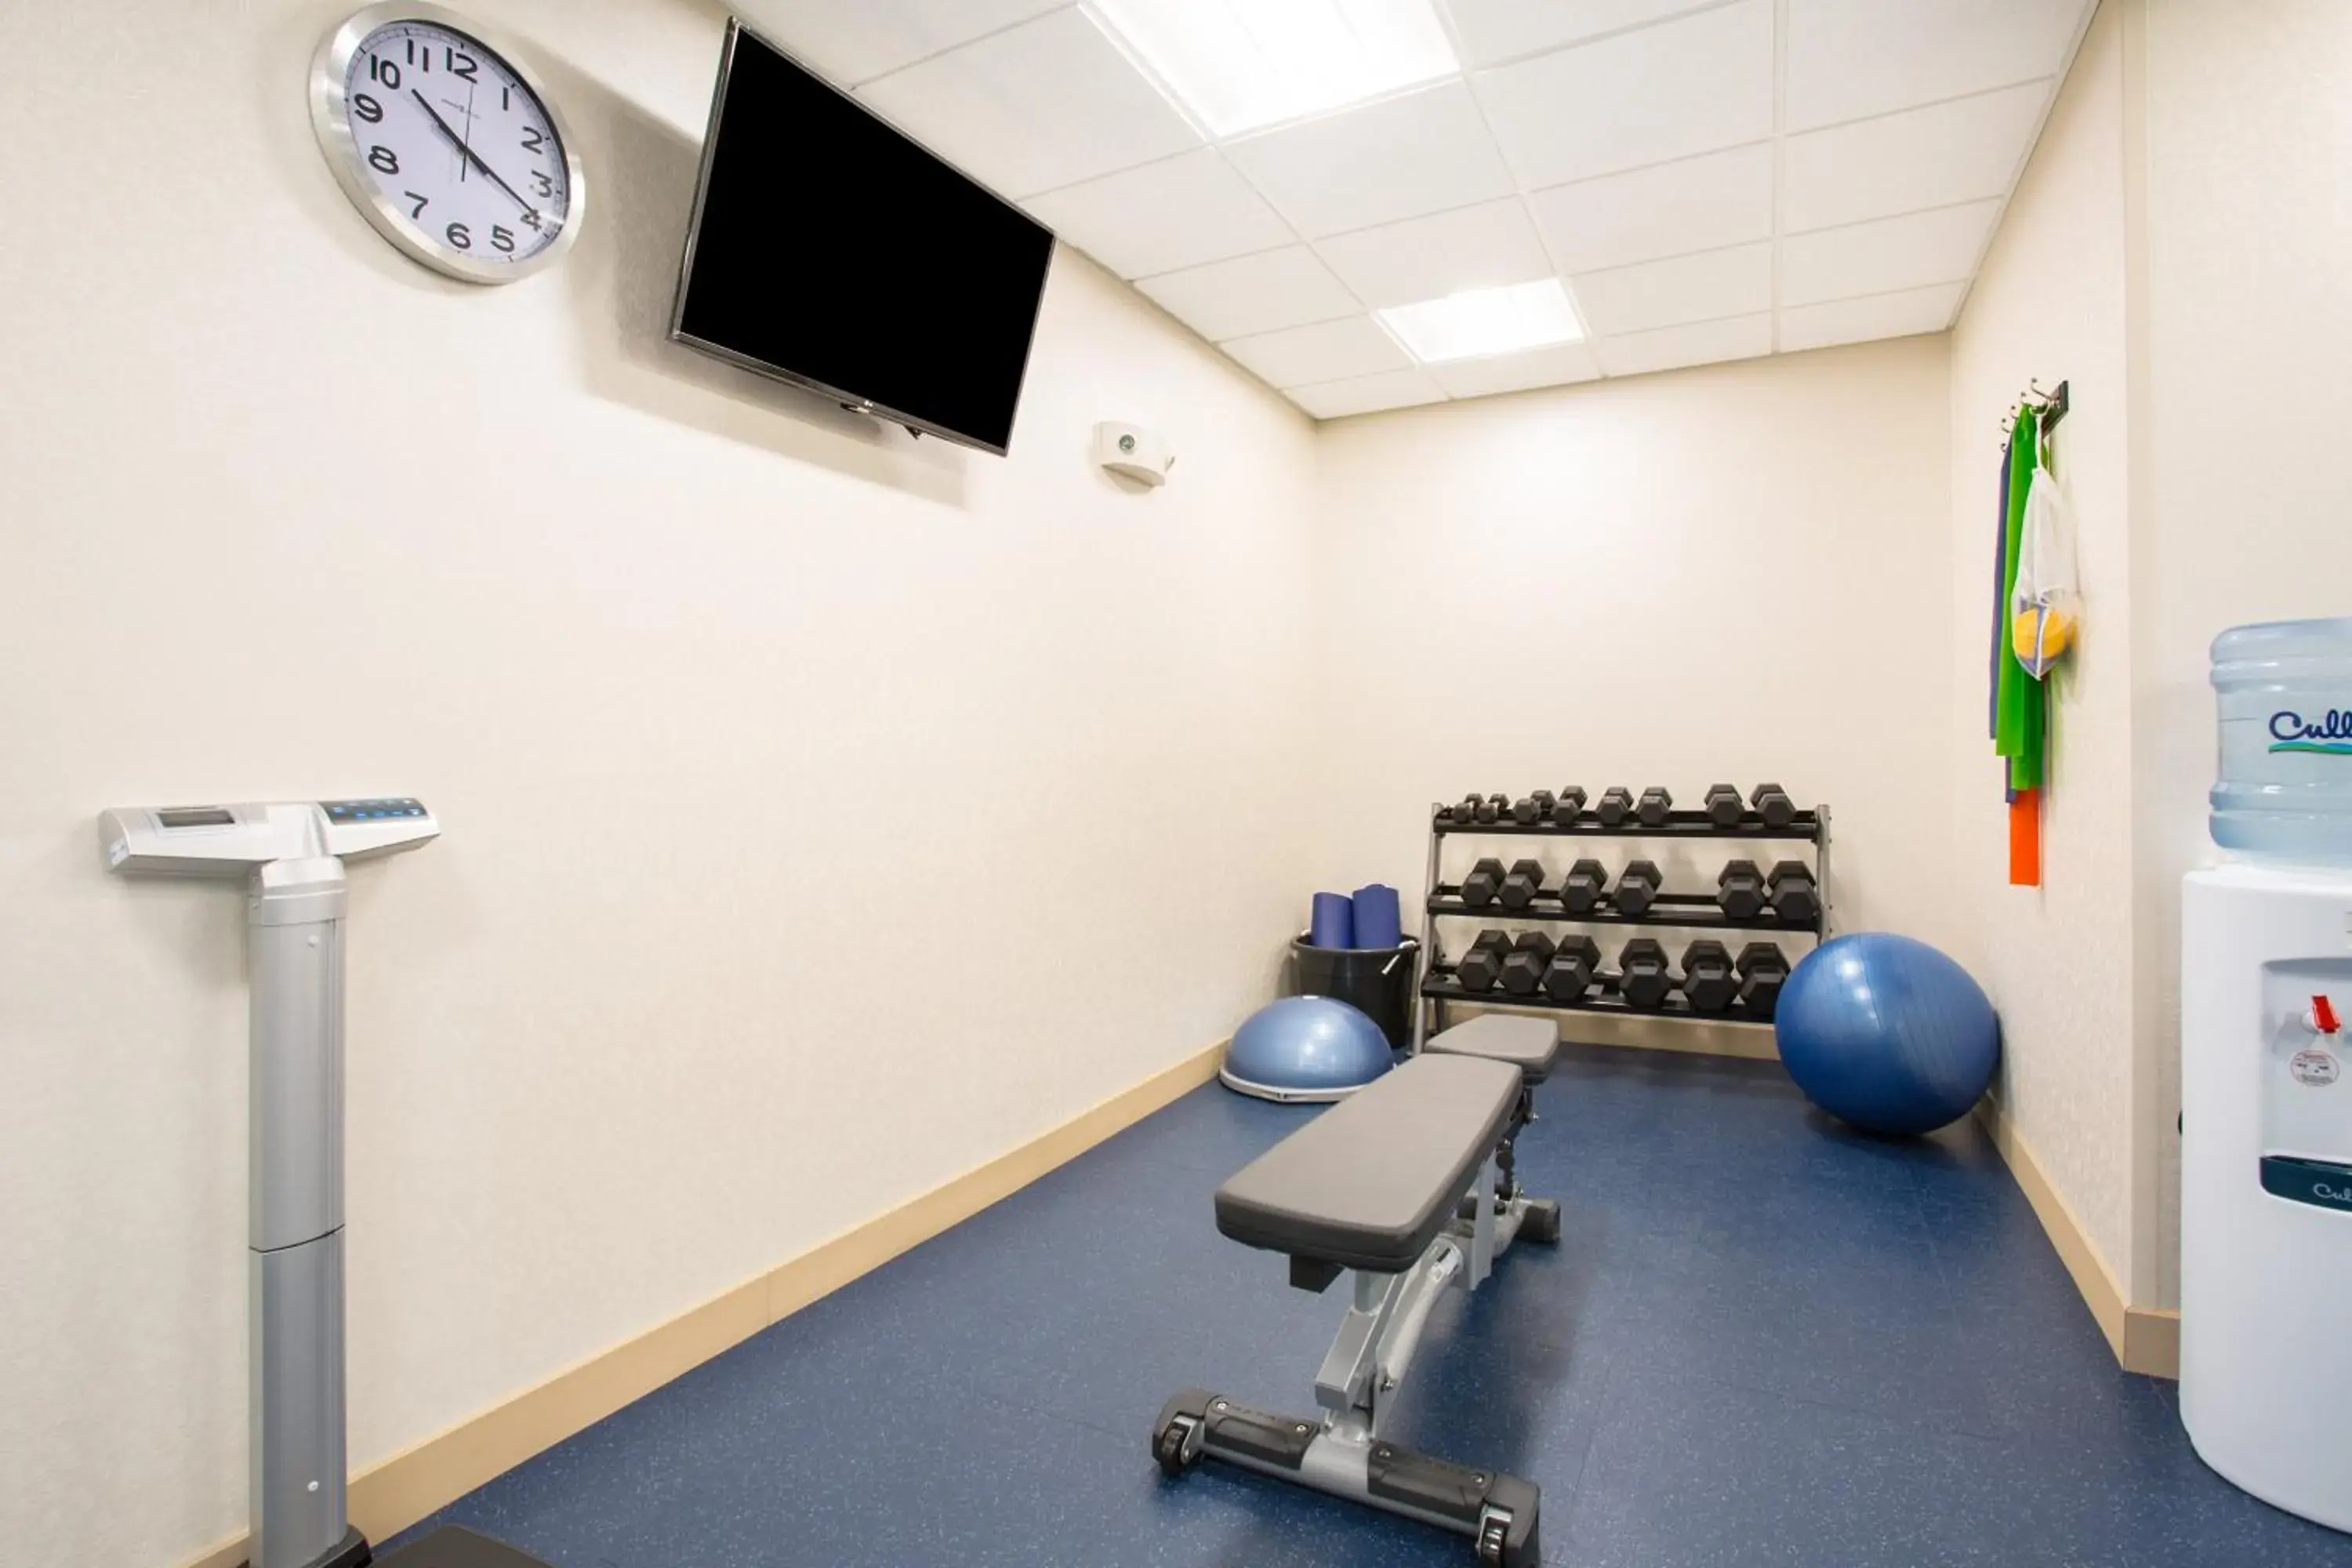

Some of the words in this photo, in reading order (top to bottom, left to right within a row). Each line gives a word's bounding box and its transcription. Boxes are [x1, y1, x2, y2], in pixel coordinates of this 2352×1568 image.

[407, 38, 430, 73] 11
[446, 46, 478, 85] 12
[371, 54, 401, 90] 10
[354, 93, 384, 124] 9
[503, 86, 510, 111] 1
[521, 125, 543, 155] 2
[368, 145, 400, 176] 8
[531, 169, 553, 198] 3
[404, 190, 429, 220] 7
[520, 209, 542, 232] 4
[446, 222, 472, 250] 6
[491, 224, 515, 253] 5
